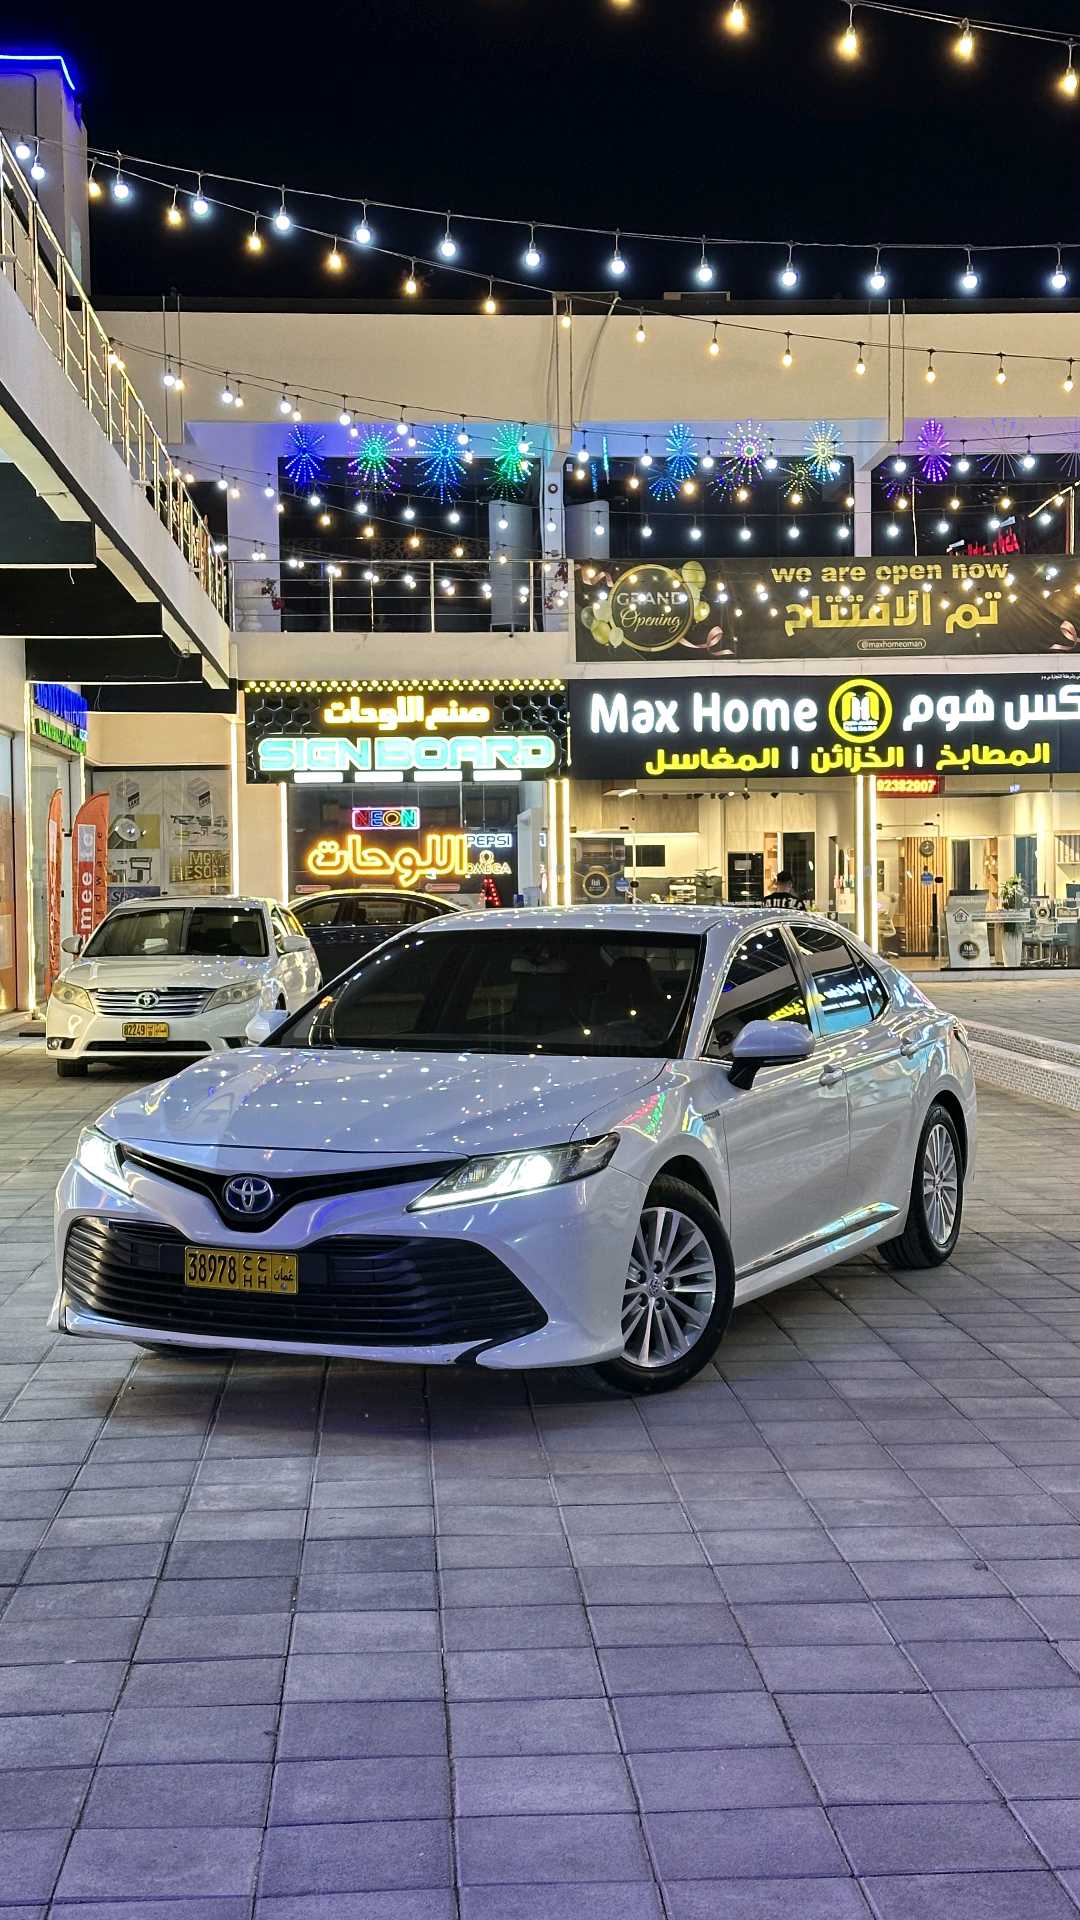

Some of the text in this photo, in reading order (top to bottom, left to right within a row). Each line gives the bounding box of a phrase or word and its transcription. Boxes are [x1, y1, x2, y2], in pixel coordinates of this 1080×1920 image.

[771, 563, 1008, 584] we are open now
[617, 592, 686, 606] GRAND
[784, 589, 1002, 637] تم الافتتاح
[620, 607, 680, 633] Opening
[324, 695, 424, 730] اللوحات
[590, 692, 818, 733] Max Home
[902, 689, 995, 732] هوم
[258, 735, 555, 771] SIGN BOARD
[645, 743, 1050, 775] المطابخ الخزائن المغاسل
[355, 809, 417, 828] NEON
[465, 834, 513, 848] PEPSI
[465, 862, 512, 875] OMEGA
[188, 1253, 237, 1285] 38978
[273, 1266, 294, 1282] عمان
